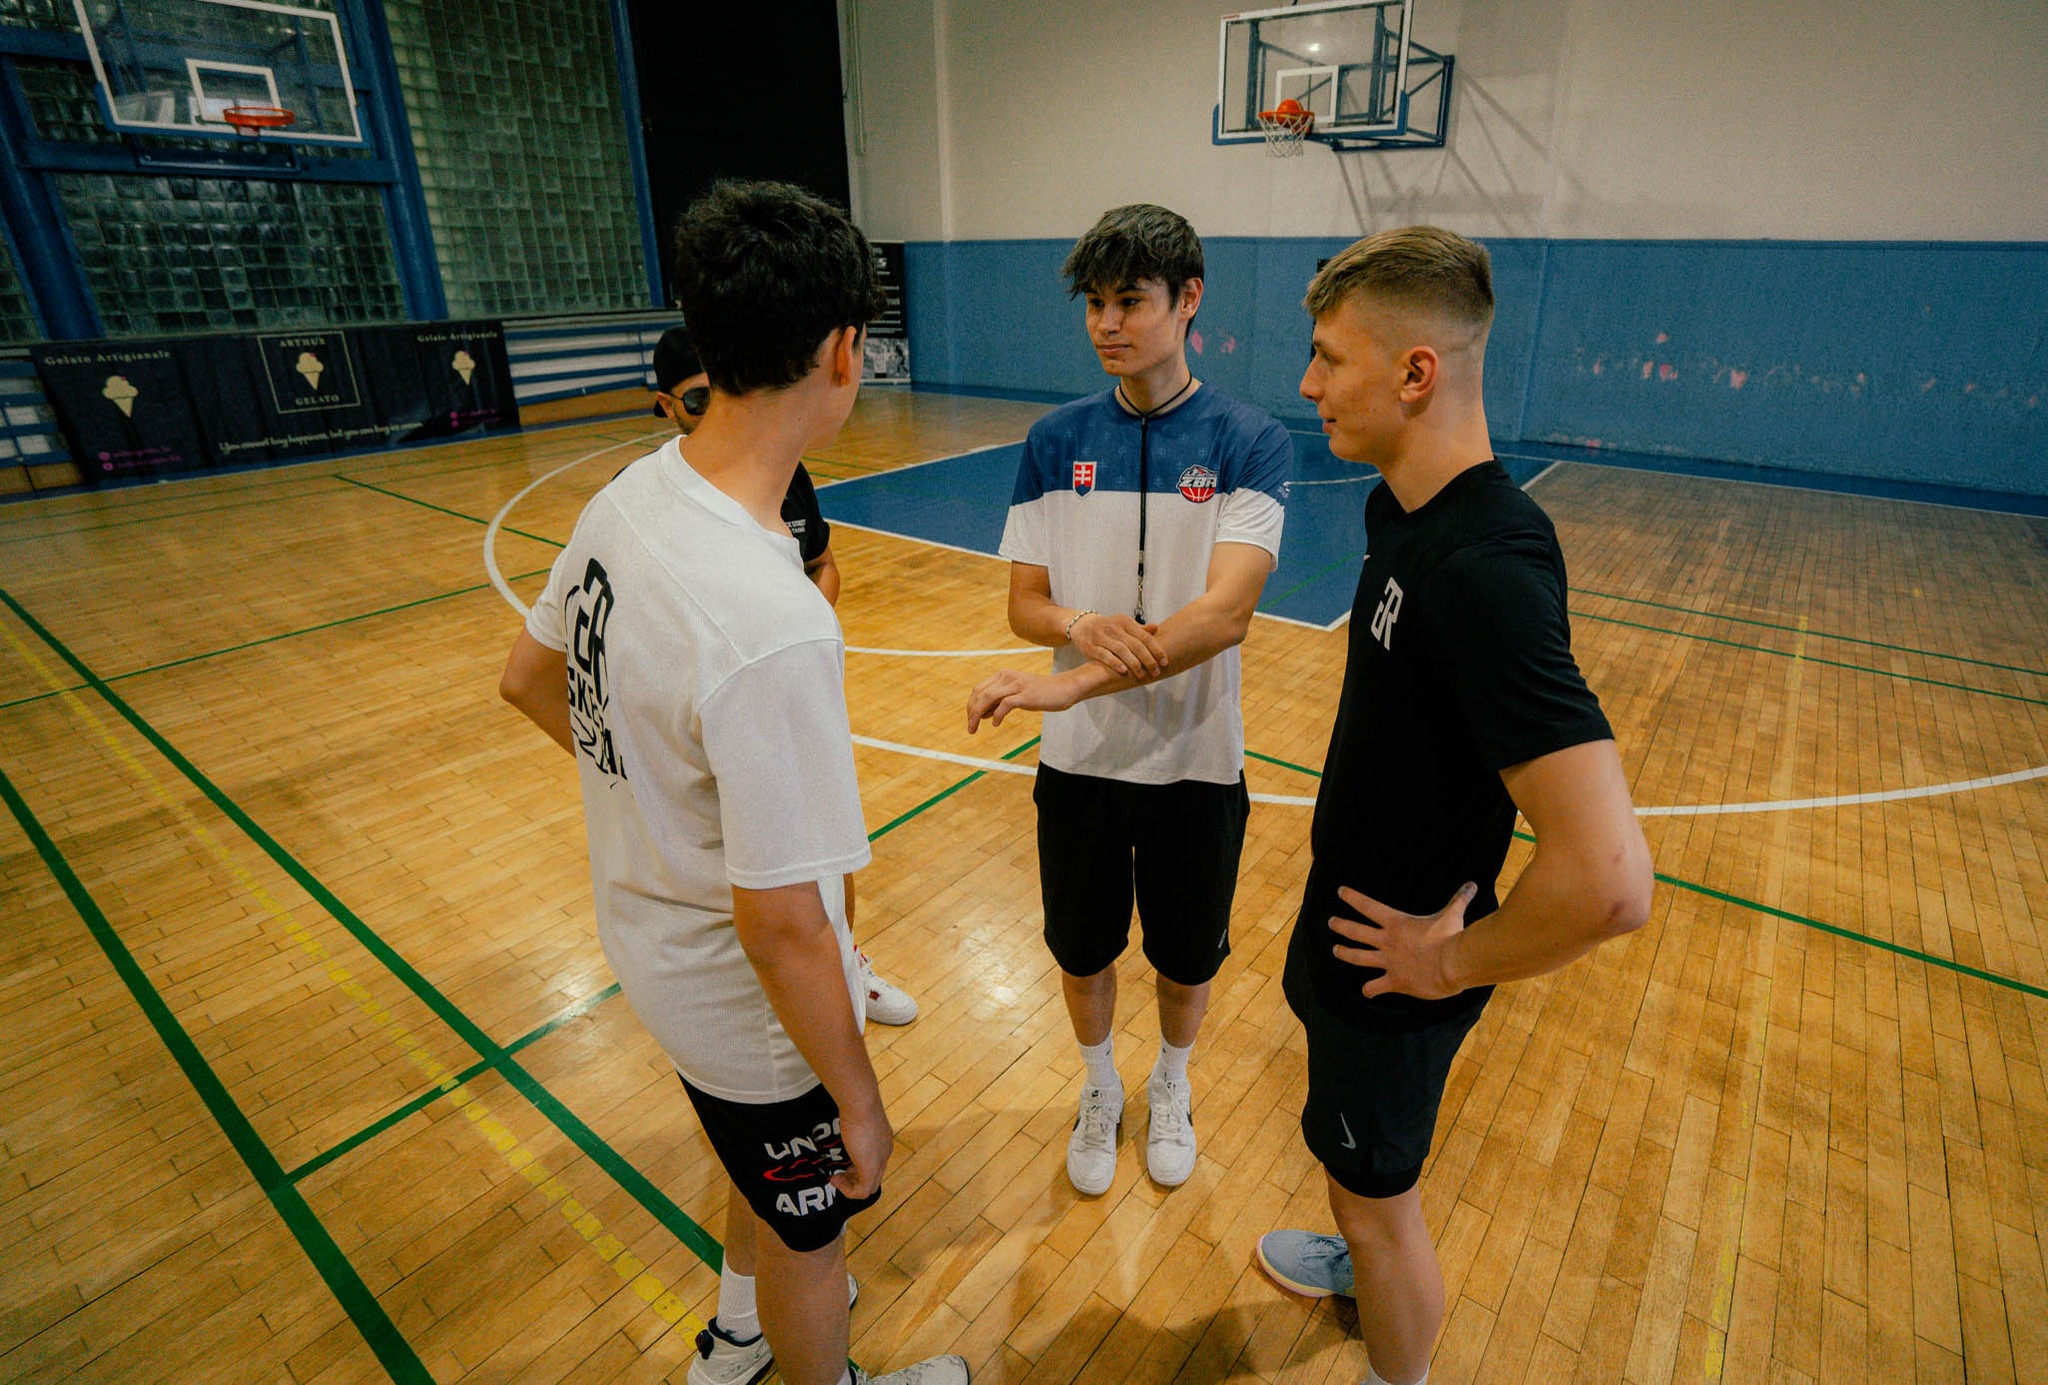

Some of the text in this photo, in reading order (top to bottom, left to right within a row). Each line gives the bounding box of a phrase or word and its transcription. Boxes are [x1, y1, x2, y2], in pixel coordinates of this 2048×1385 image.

[44, 355, 91, 366] Gelato
[295, 394, 340, 406] GELATO
[1179, 476, 1218, 488] ZBA
